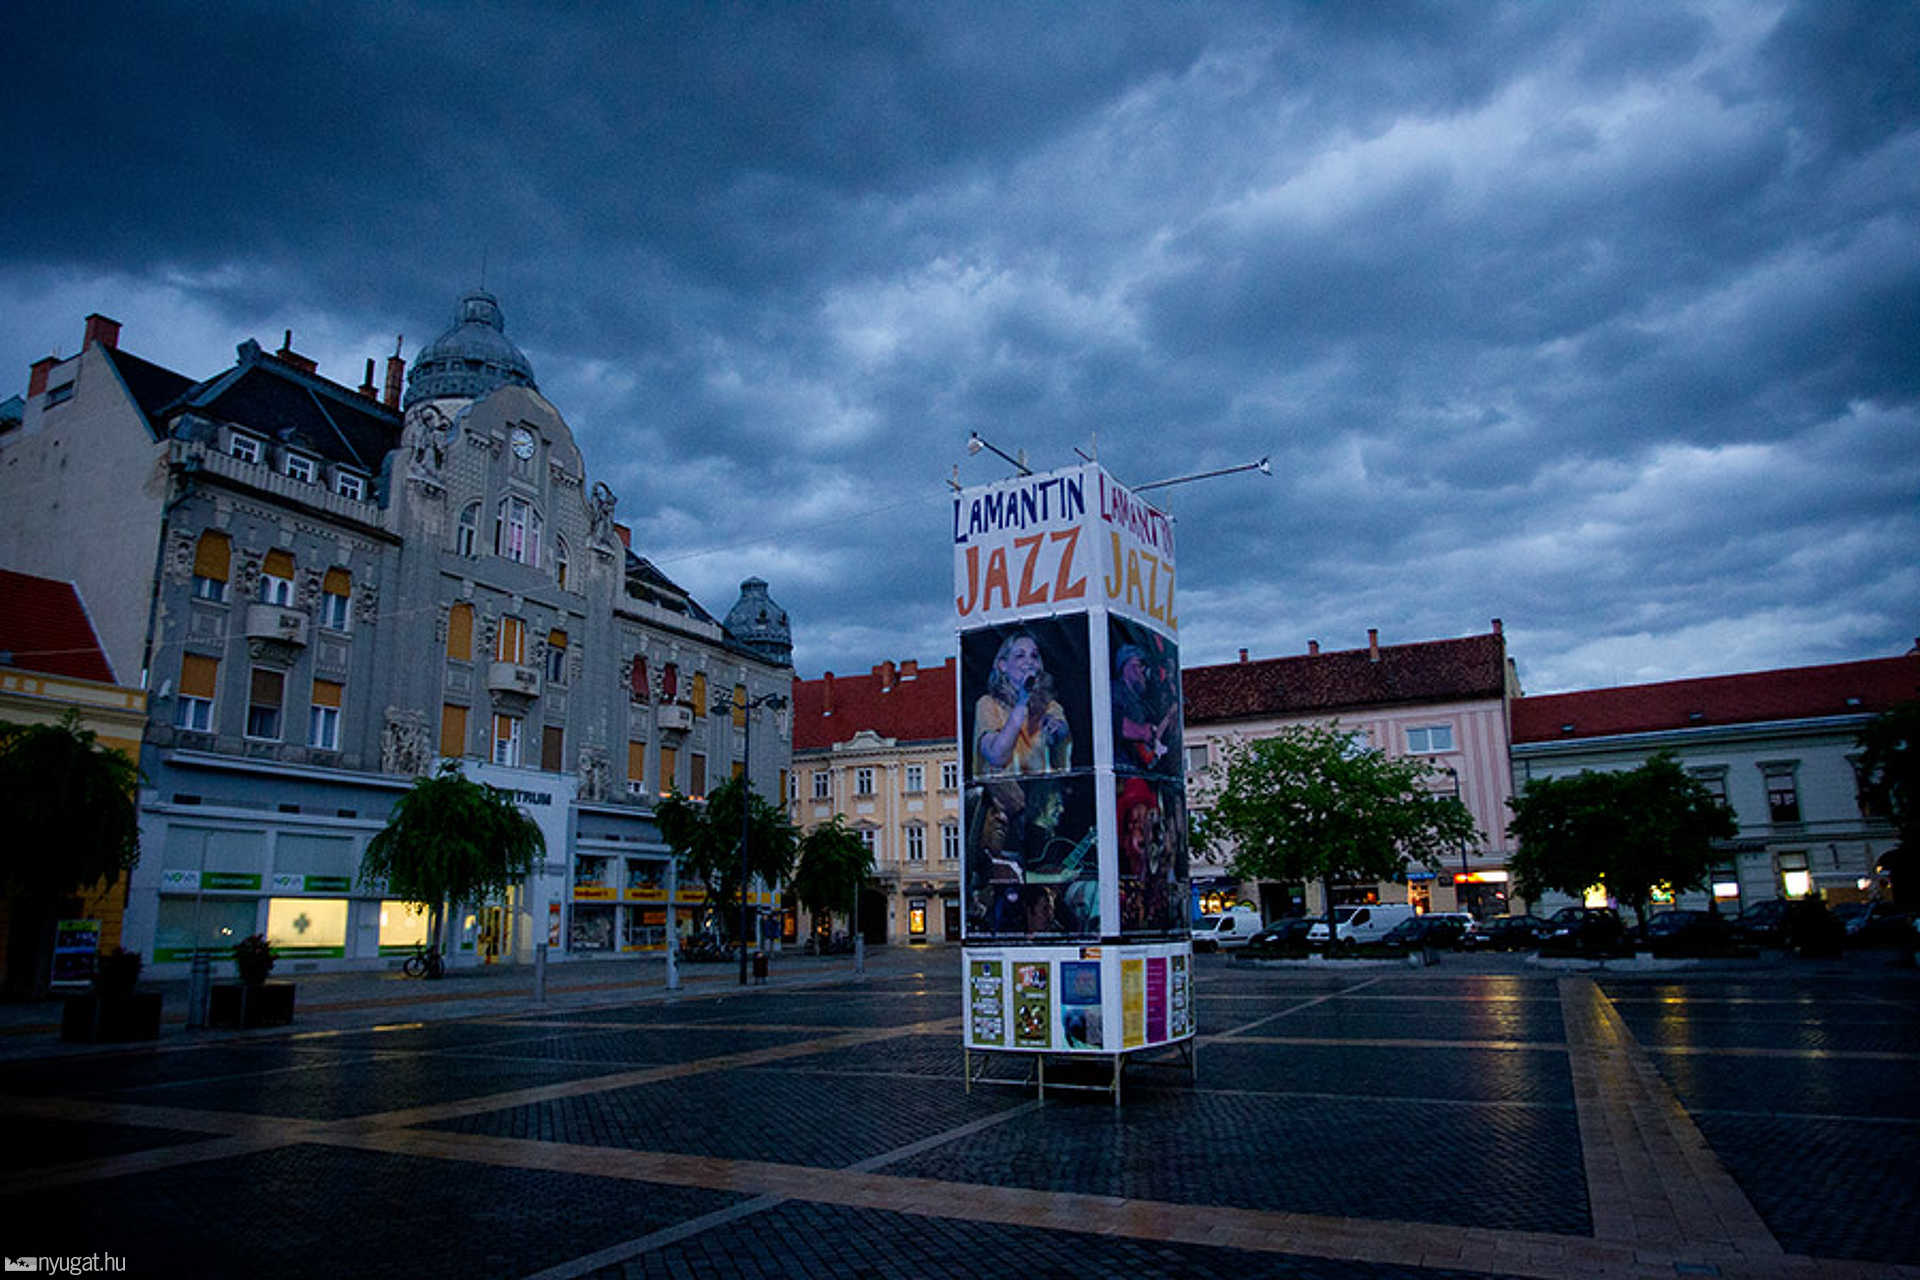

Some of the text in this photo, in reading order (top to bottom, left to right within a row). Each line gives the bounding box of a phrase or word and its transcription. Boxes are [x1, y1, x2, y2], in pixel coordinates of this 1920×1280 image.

[954, 473, 1085, 543] LAMANTIN
[1099, 473, 1174, 559] LAMANTIN
[956, 525, 1087, 617] JAZZ
[1104, 530, 1178, 631] JAZZ
